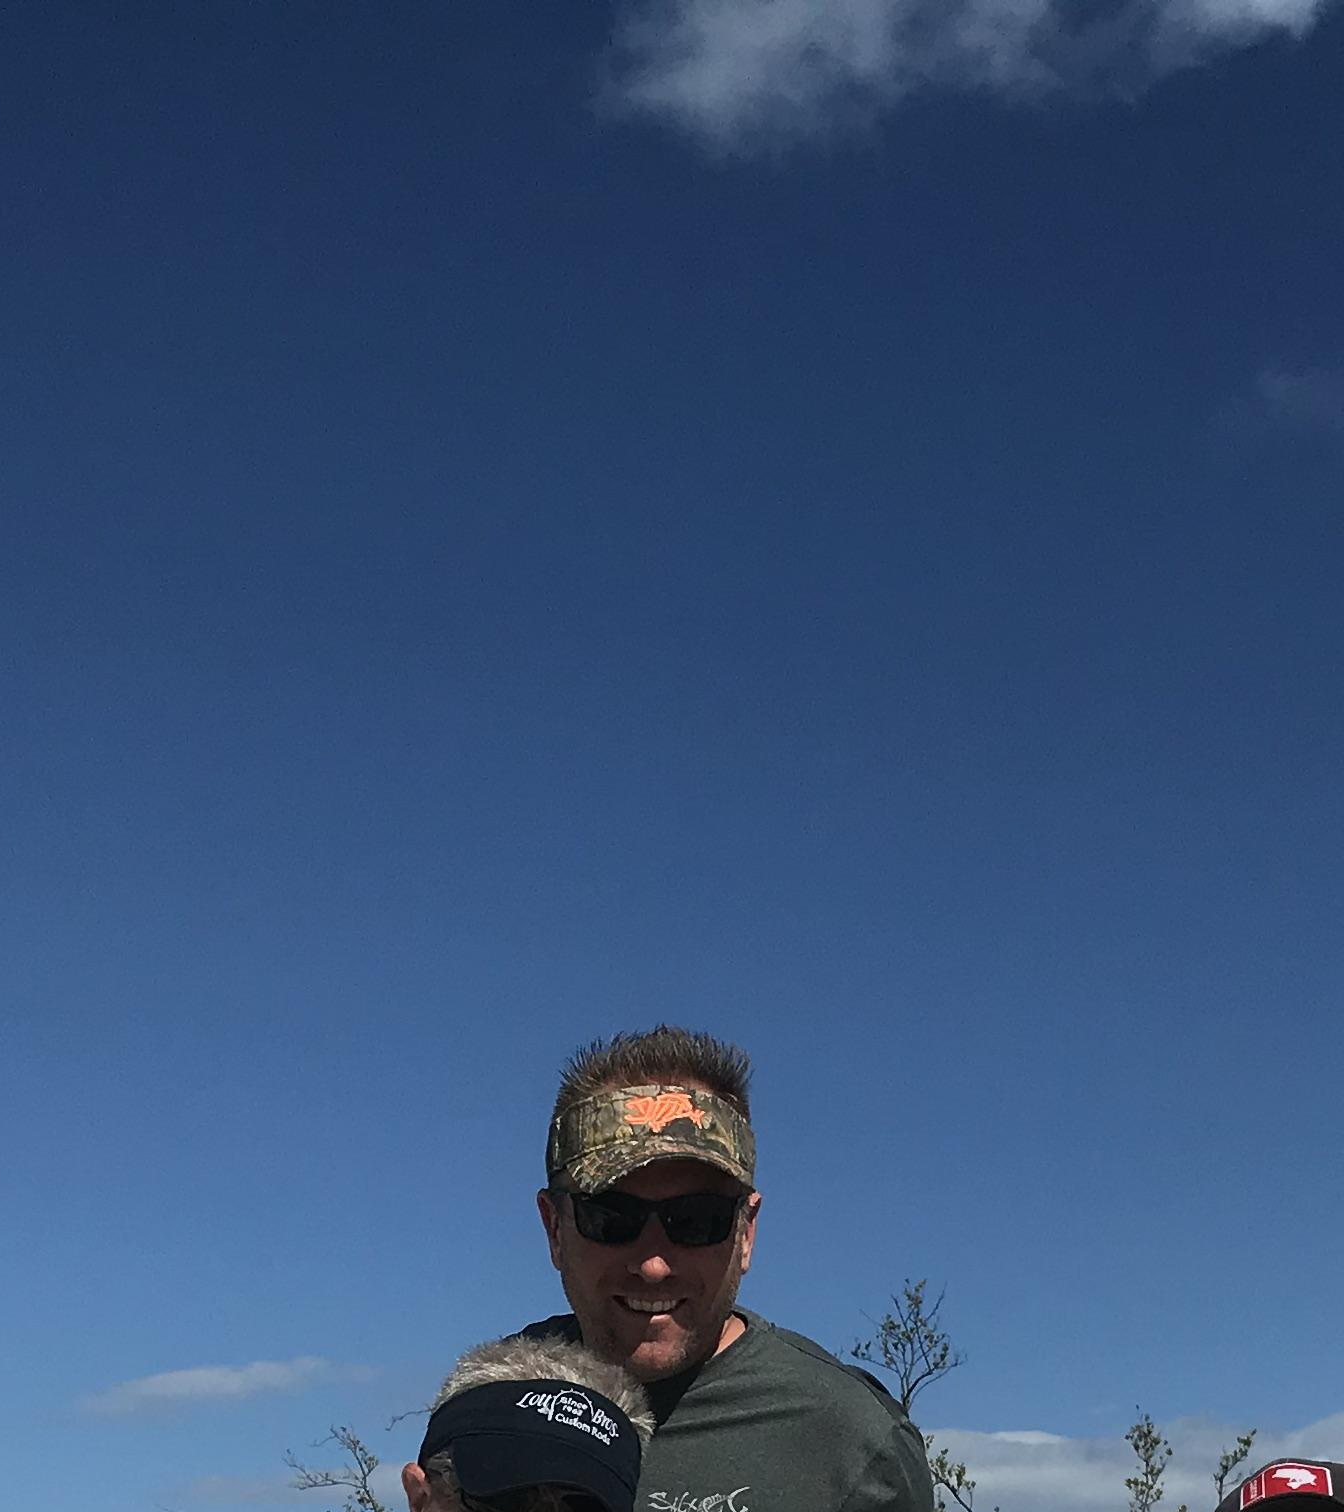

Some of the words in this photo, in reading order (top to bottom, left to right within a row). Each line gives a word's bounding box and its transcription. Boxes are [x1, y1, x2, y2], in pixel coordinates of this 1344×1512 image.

[554, 1413, 591, 1434] Custom
[591, 1426, 611, 1446] Rods
[591, 1408, 620, 1438] Bros.
